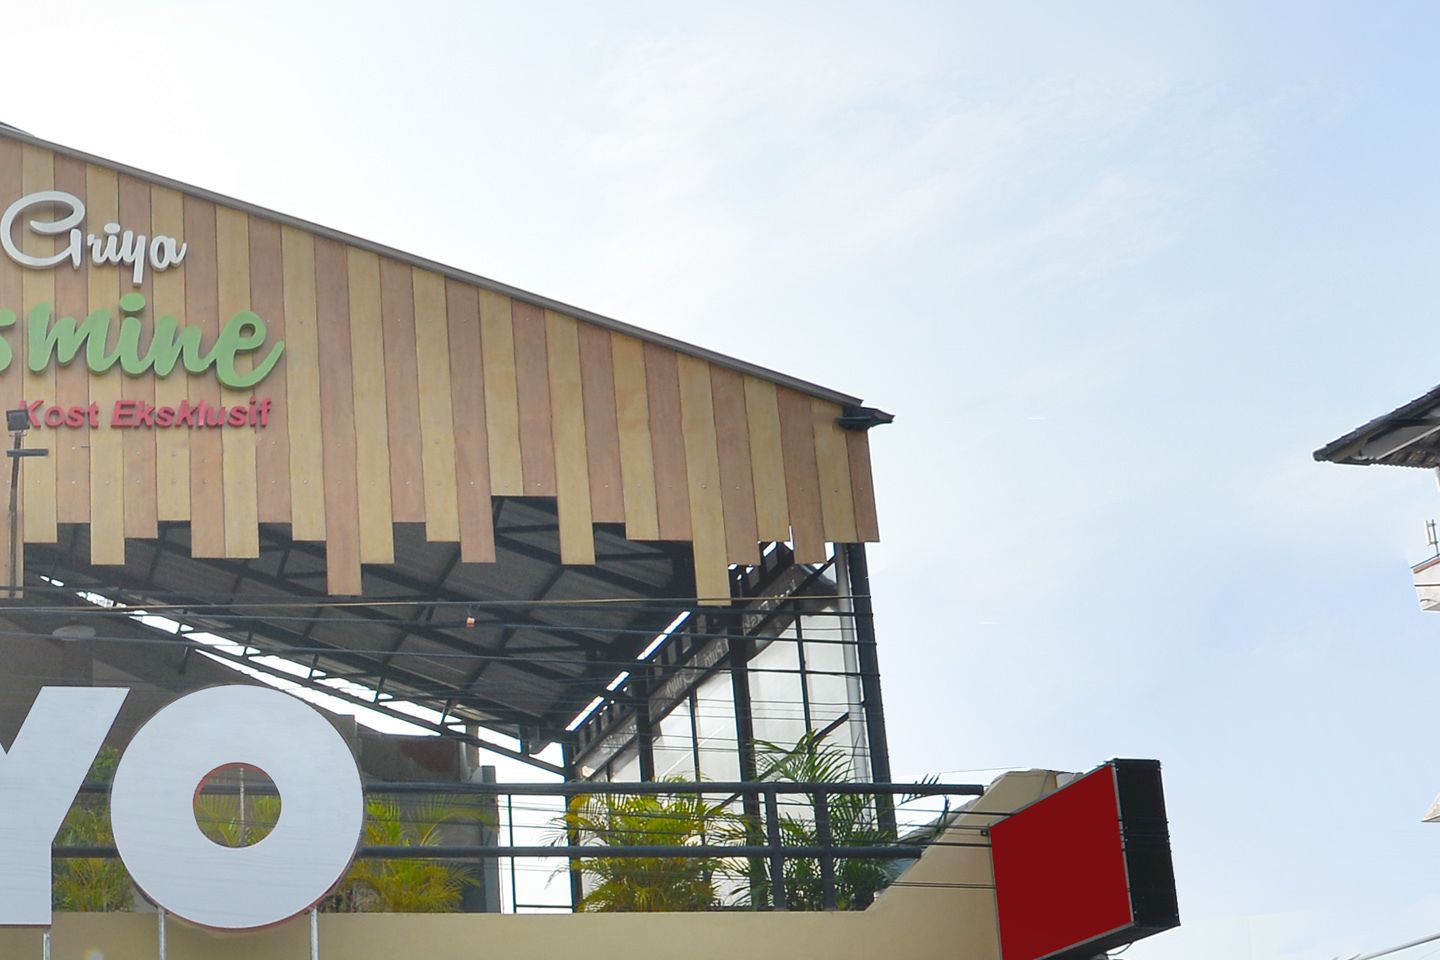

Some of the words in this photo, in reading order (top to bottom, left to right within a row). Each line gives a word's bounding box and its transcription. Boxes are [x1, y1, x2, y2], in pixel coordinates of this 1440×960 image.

[0, 190, 188, 287] Griya
[19, 400, 100, 428] Kost
[110, 396, 272, 429] Eksklusif
